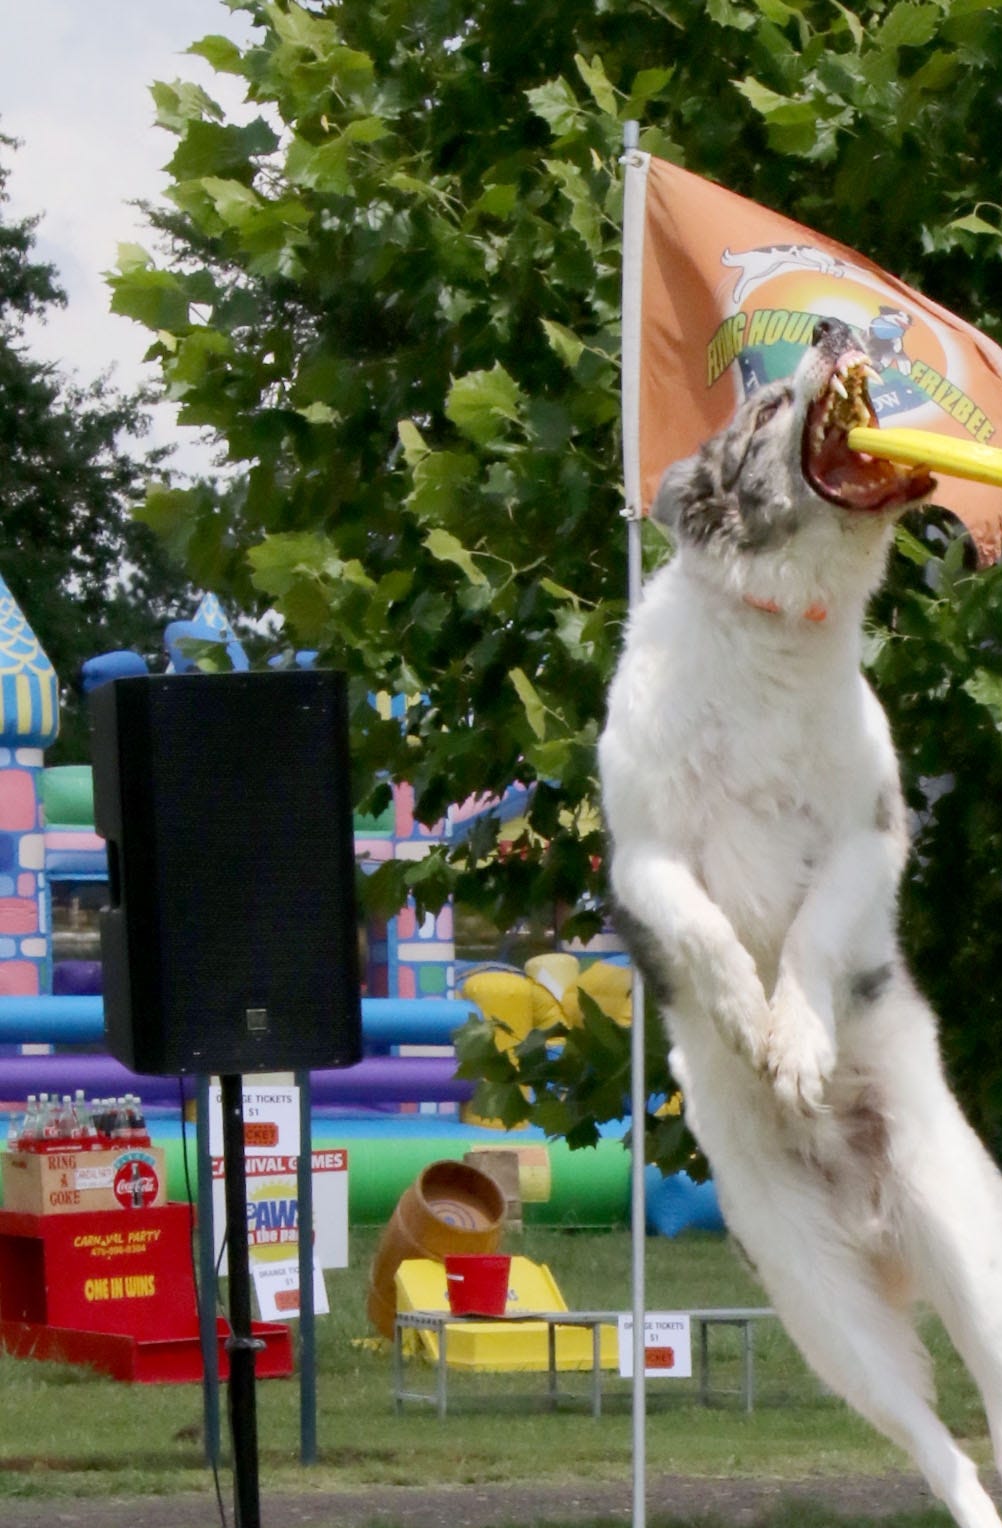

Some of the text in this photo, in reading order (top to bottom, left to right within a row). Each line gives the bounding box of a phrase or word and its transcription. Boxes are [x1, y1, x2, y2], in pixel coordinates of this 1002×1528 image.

[747, 308, 823, 347] HOU
[911, 359, 997, 444] FRIZBEE
[216, 1095, 292, 1104] OGE TICKETS
[48, 1156, 77, 1170] RING
[212, 1153, 343, 1176] CANIVAL GMES
[246, 1200, 298, 1230] PAW
[256, 1226, 278, 1243] the
[85, 1275, 155, 1302] ONE IN WINS
[623, 1322, 684, 1330] ORGE TICKETS
